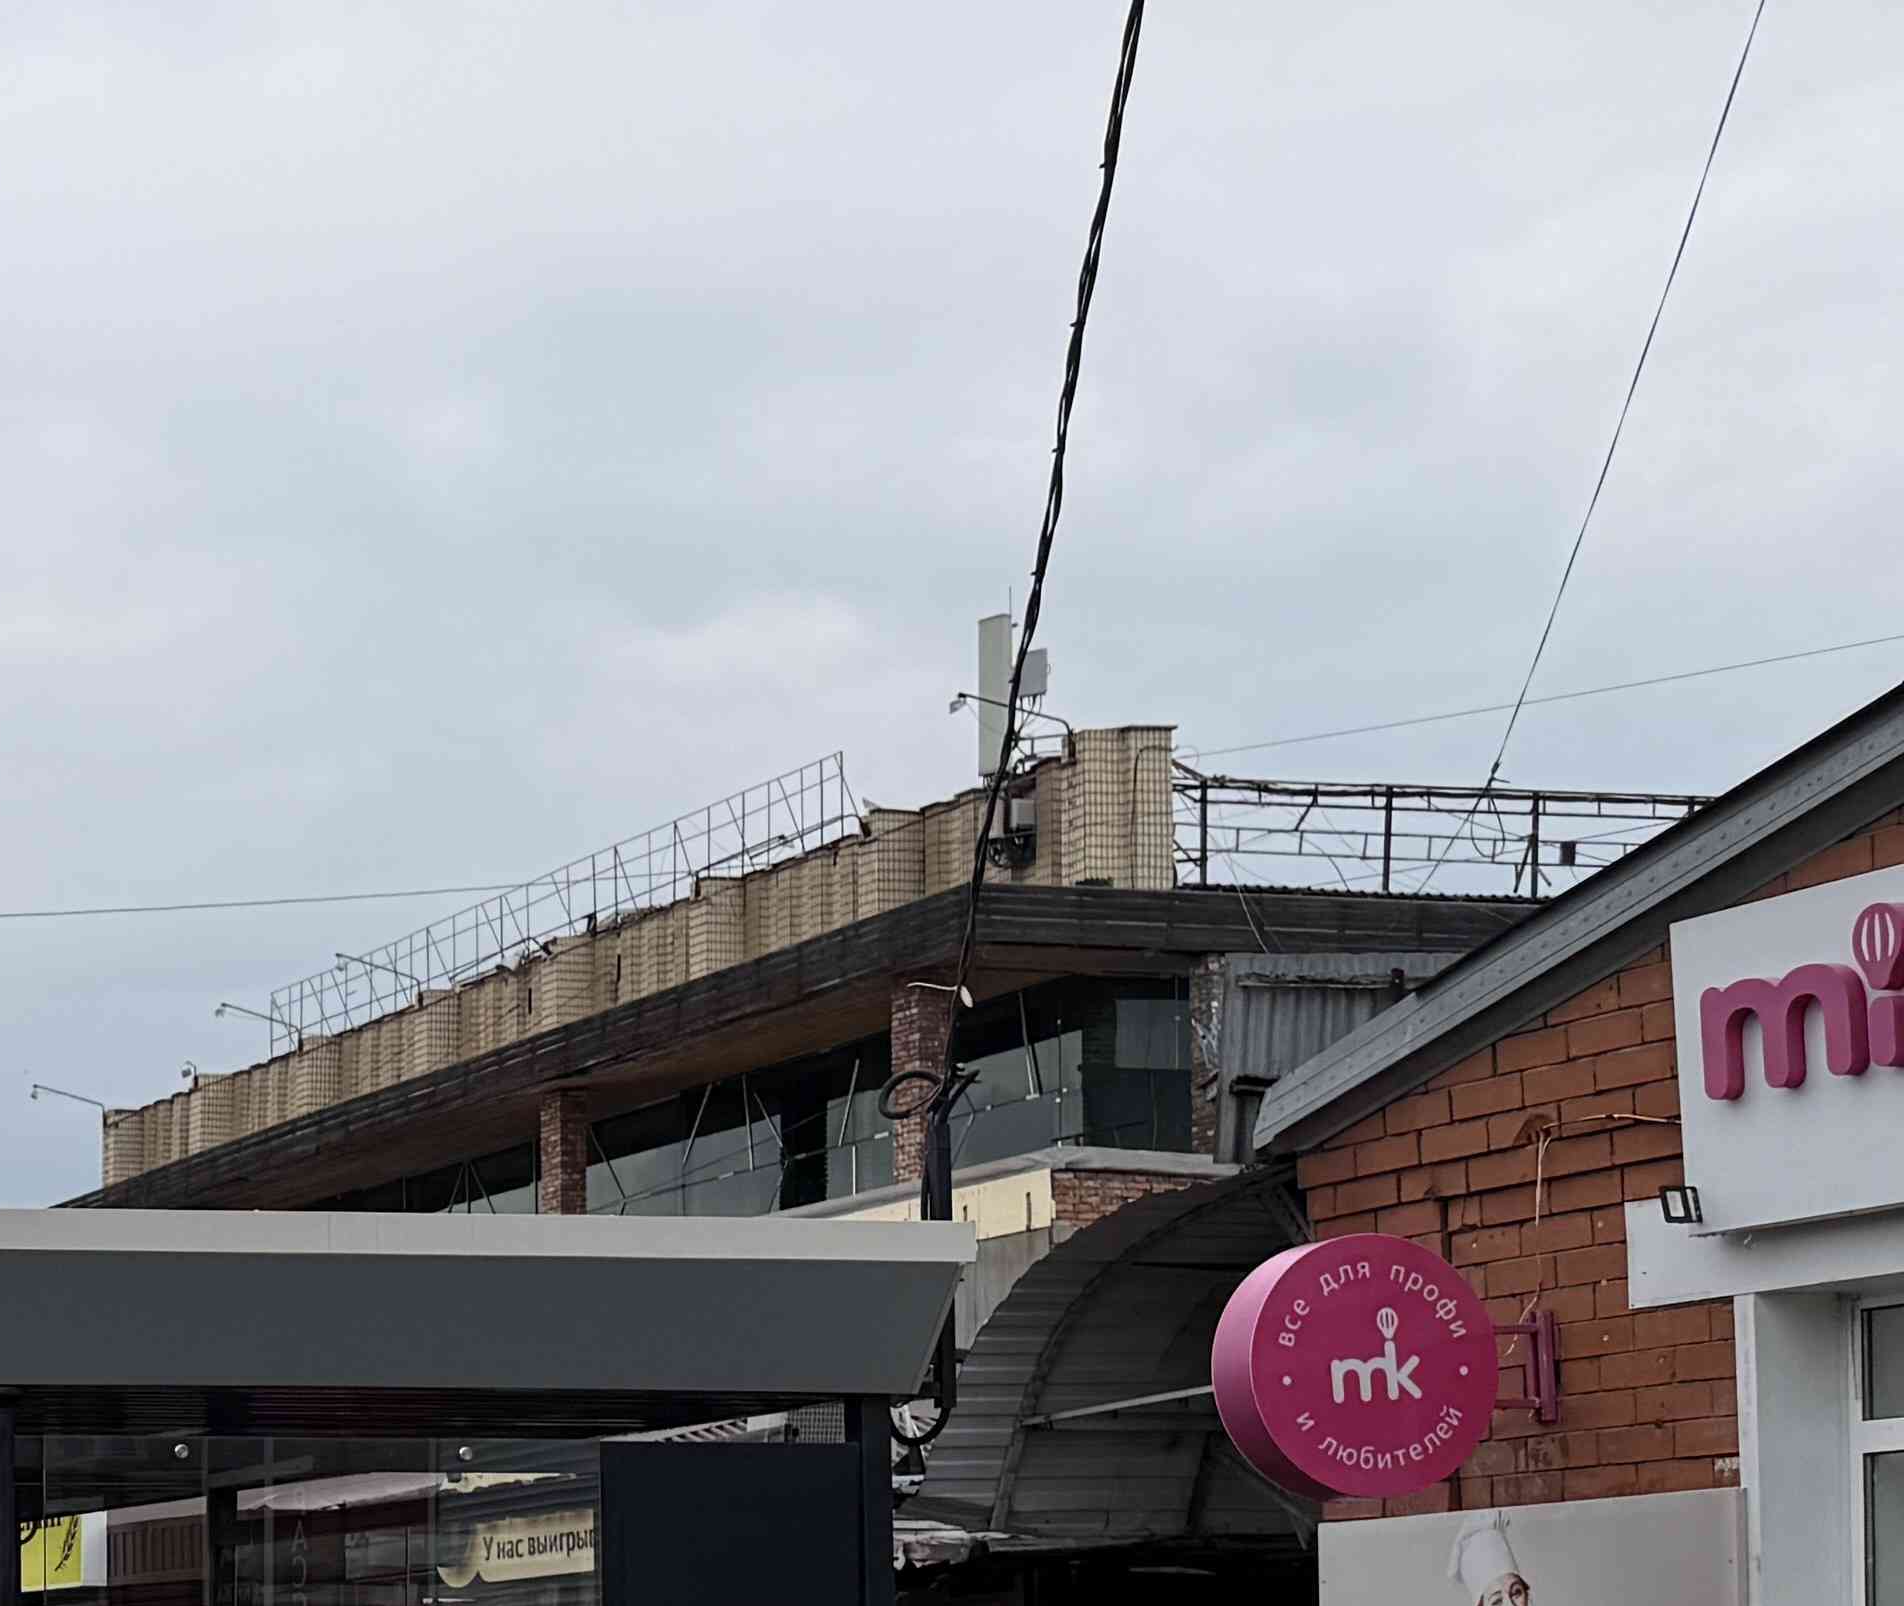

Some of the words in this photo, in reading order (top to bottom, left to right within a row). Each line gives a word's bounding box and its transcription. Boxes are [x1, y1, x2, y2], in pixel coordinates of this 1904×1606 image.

[1319, 1261, 1371, 1296] для
[1390, 1264, 1467, 1338] профи
[1296, 1412, 1315, 1431] и
[1318, 1404, 1463, 1469] любителей
[482, 1535, 494, 1561] У
[497, 1538, 524, 1560] нас
